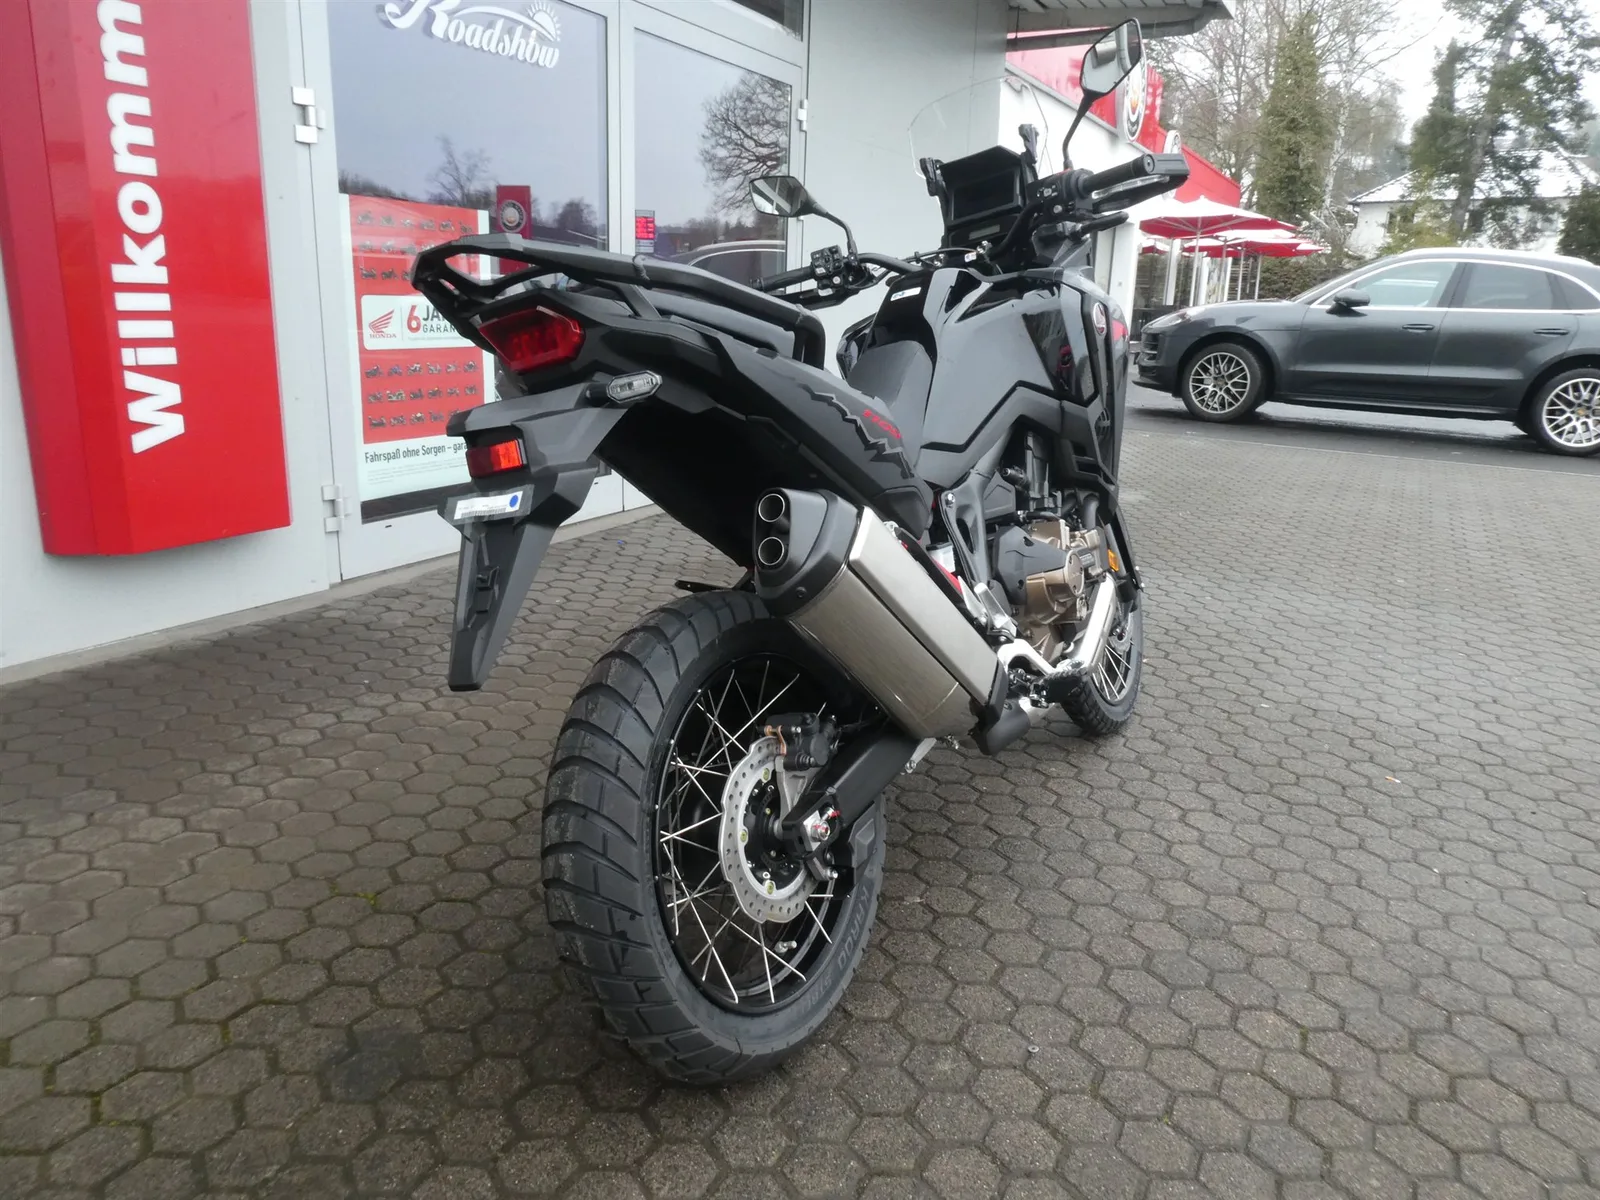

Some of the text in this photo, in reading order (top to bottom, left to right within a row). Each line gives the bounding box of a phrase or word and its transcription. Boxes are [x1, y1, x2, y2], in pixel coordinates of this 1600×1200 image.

[384, 0, 560, 68] Roadshow
[97, 0, 186, 454] Willkomm
[407, 305, 422, 334] 6
[364, 448, 401, 464] Fahrspaß
[402, 447, 420, 458] ohne
[421, 444, 446, 456] Sorgen
